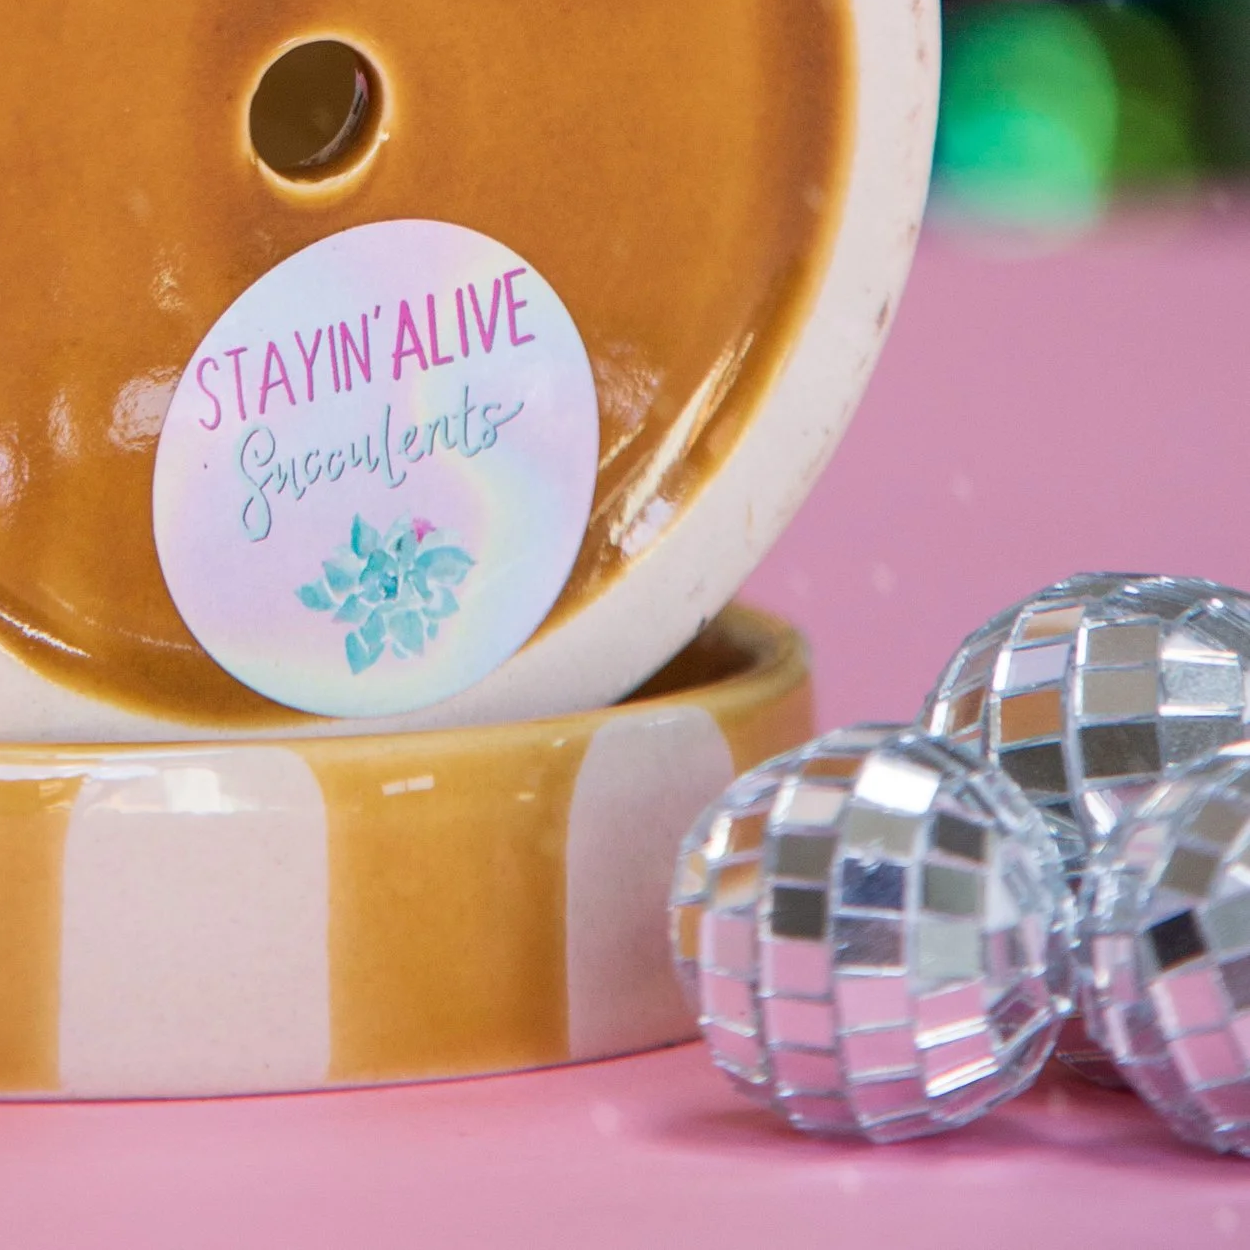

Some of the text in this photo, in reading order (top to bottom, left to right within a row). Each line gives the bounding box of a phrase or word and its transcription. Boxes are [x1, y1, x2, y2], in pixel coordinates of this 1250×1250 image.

[196, 267, 535, 431] STAYIN' ALIVE
[239, 385, 524, 542] Succulents
